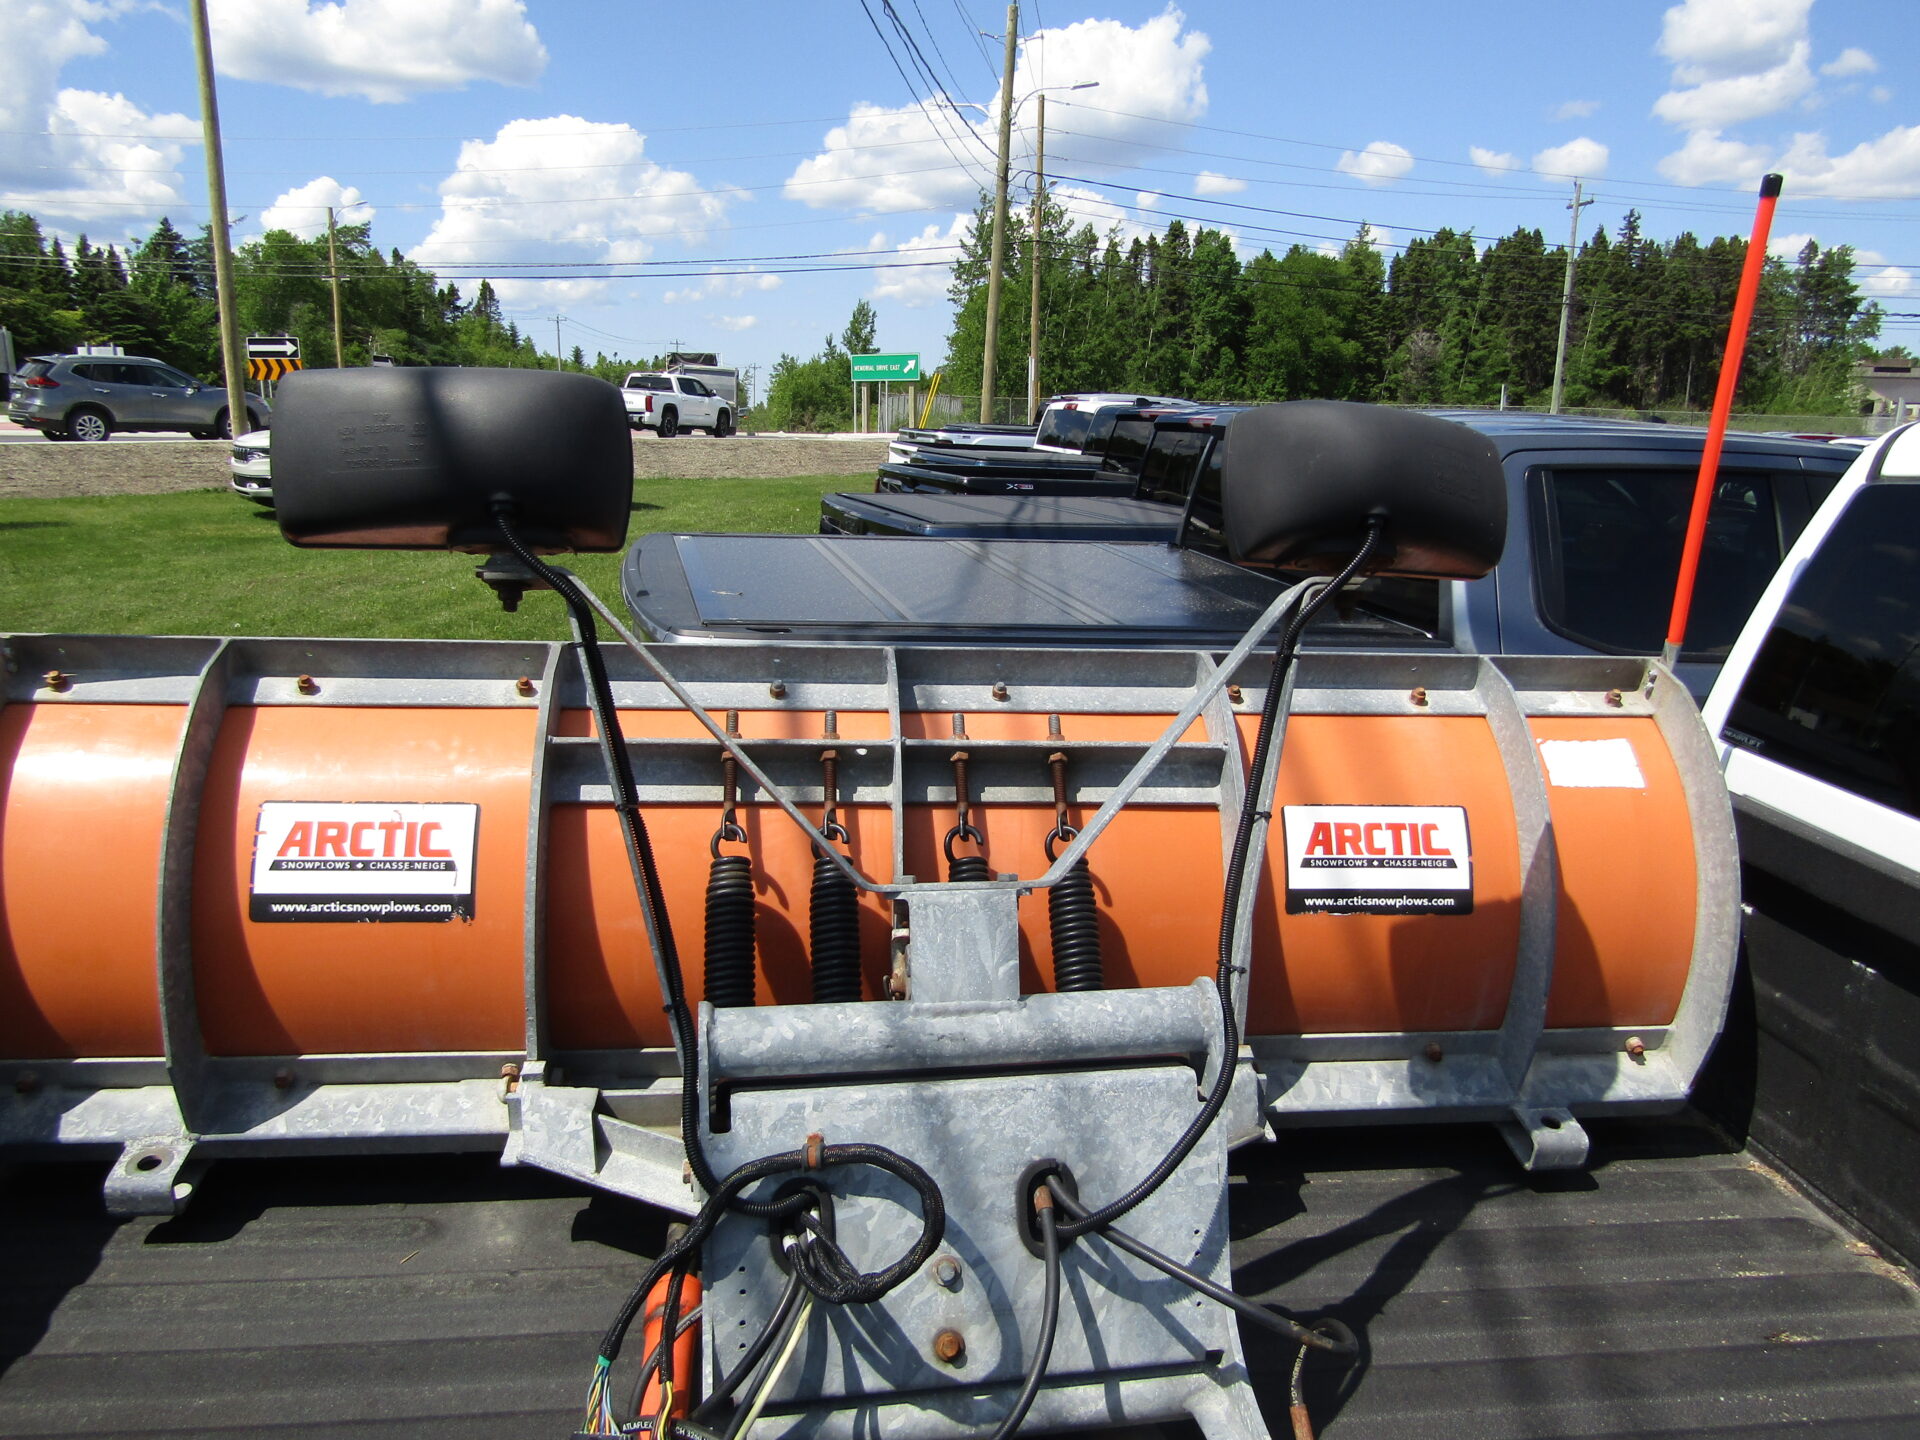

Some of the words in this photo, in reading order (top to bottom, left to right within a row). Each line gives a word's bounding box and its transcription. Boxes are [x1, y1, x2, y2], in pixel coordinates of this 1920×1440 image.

[276, 821, 453, 857] ARCTIC
[1304, 822, 1452, 856] ARCTIC
[281, 861, 351, 869] SNOWPLOWS
[369, 861, 446, 870] CHASSE-NEIGE
[1310, 859, 1368, 867] SNOWPLOWS
[1383, 859, 1448, 867] CHASSE-NEIGE
[271, 901, 452, 915] www.arcticsnowplows.com
[1304, 895, 1455, 908] www.arcticsnowplows.com
